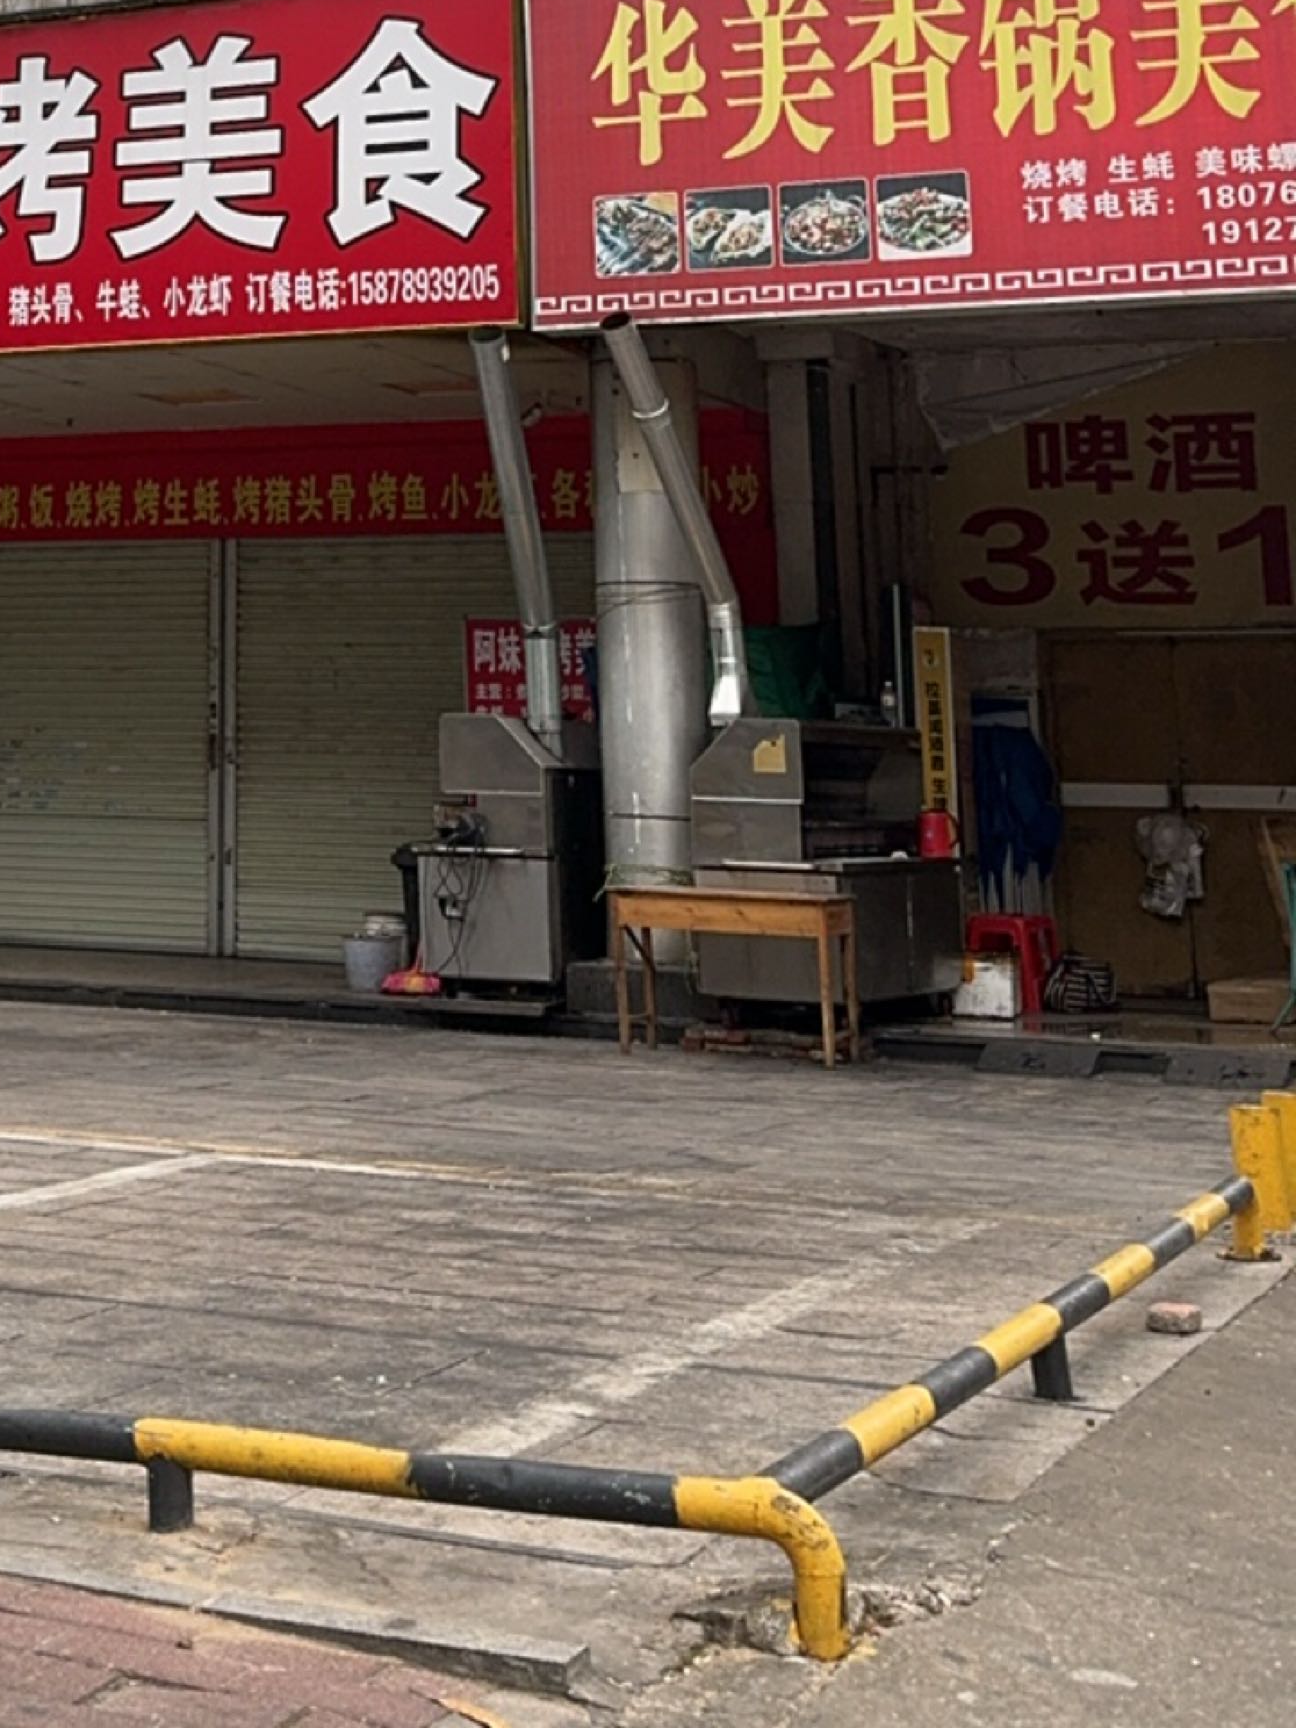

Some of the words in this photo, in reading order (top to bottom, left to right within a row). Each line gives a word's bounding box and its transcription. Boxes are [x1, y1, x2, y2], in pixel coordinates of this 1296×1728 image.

[1020, 157, 1088, 190] 烧烤
[1108, 150, 1175, 183] 生蚝
[1024, 410, 1259, 494] 啤酒
[959, 503, 1294, 610] 3送1
